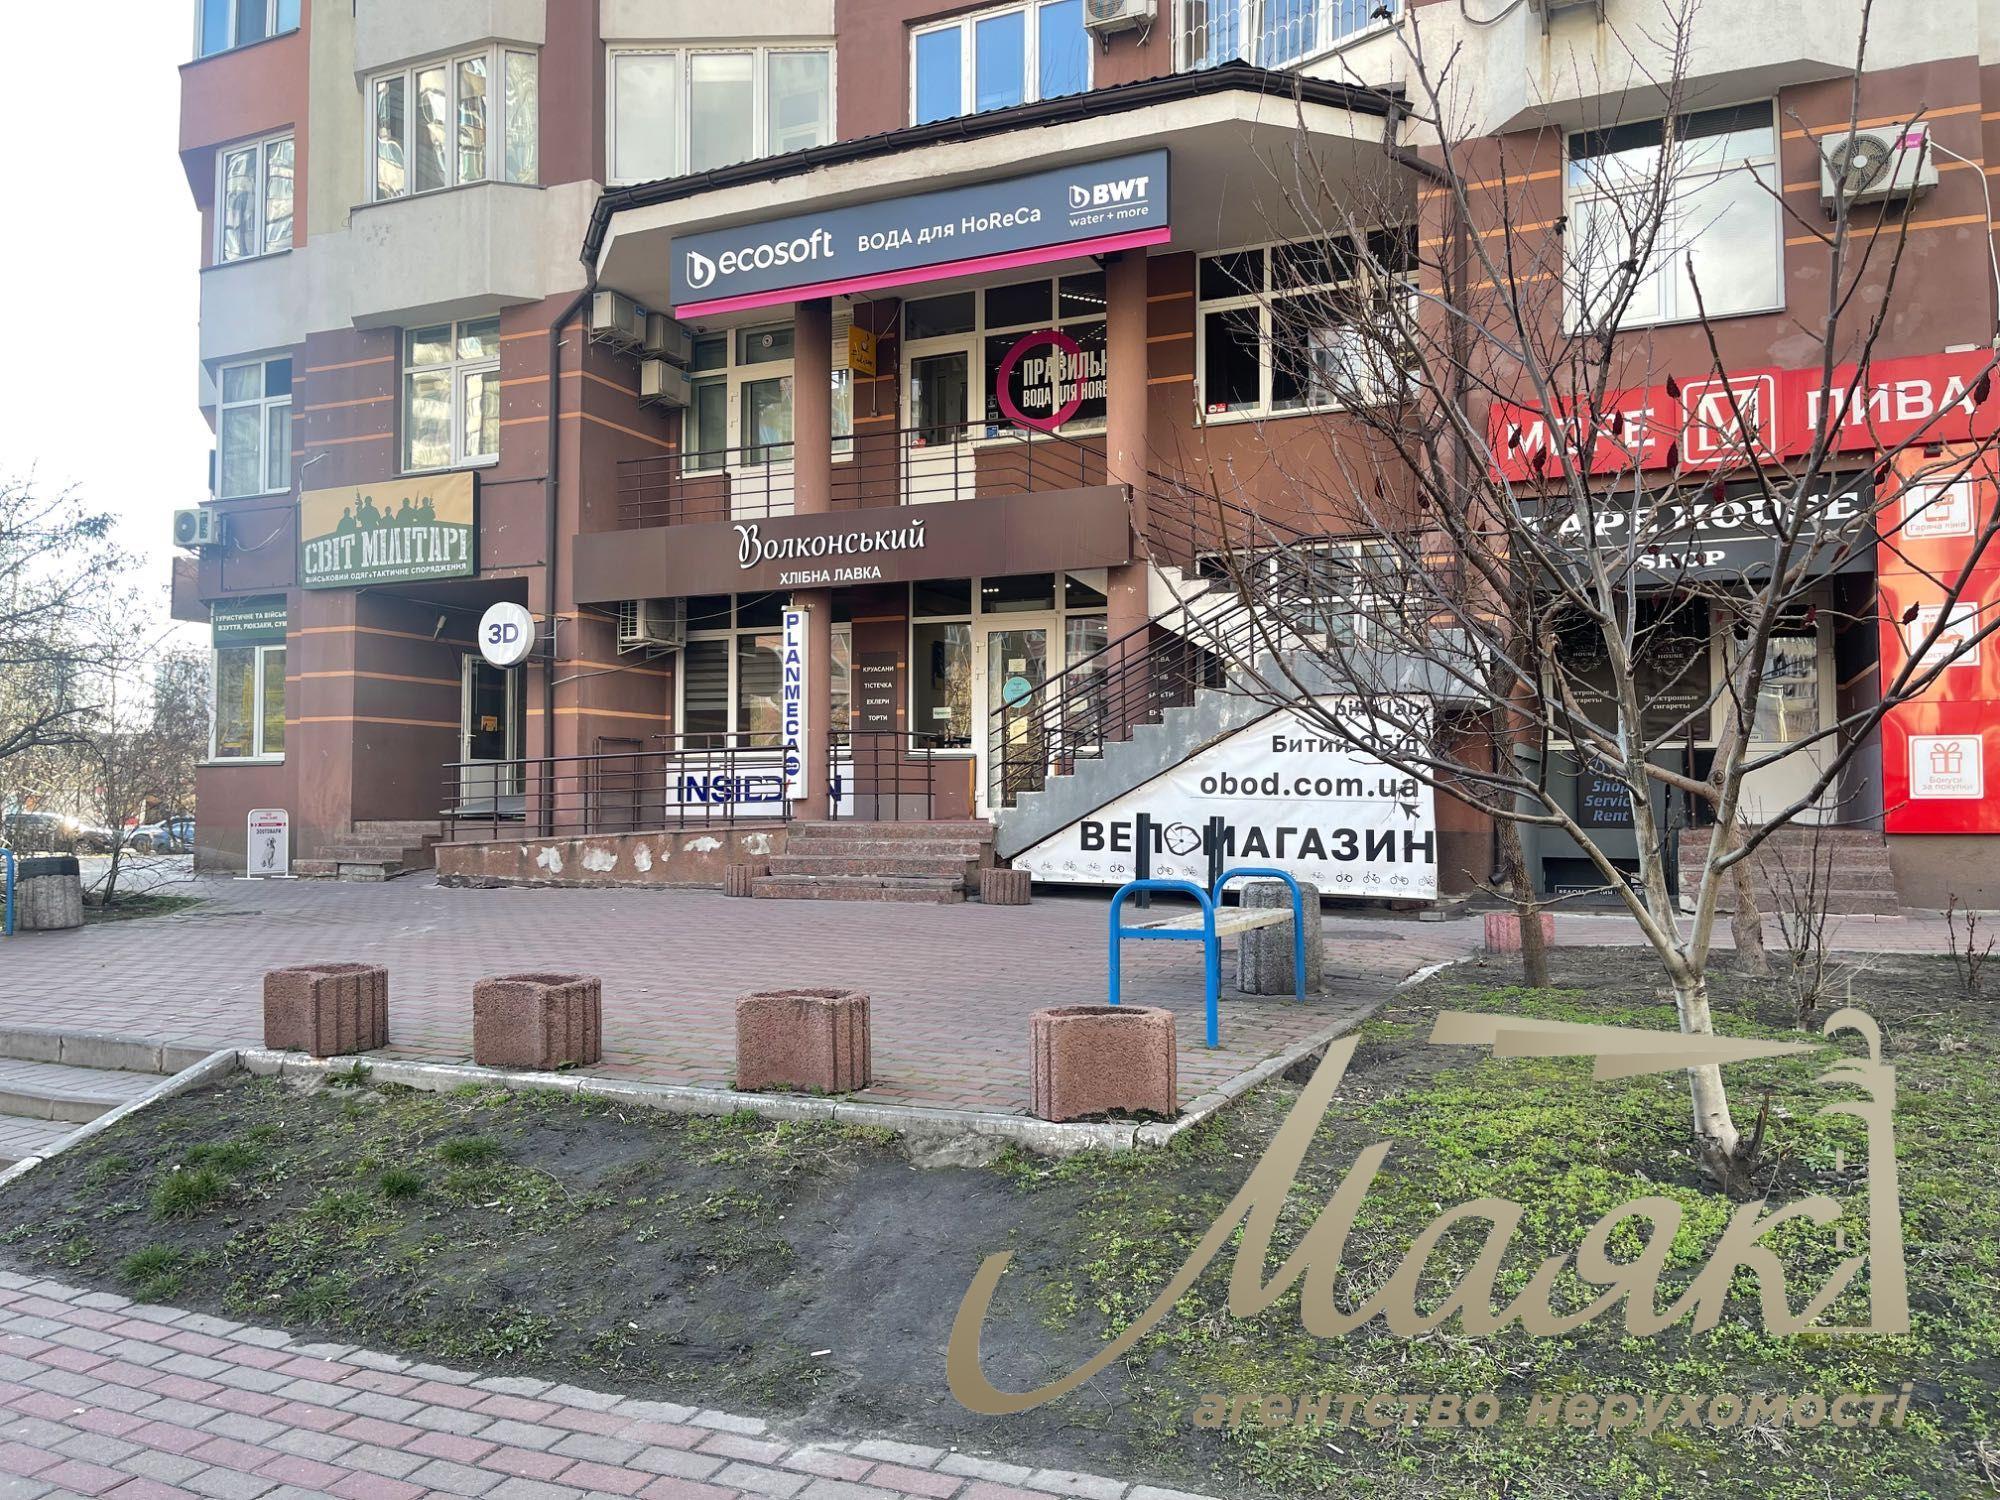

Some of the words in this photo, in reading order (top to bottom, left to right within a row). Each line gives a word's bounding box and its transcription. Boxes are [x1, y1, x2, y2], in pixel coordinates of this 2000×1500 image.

[1092, 176, 1149, 206] BWT
[858, 227, 912, 252] ВОДА
[917, 223, 954, 244] для
[961, 207, 1041, 233] HoReCa
[1069, 211, 1104, 227] water
[1116, 206, 1149, 220] more
[719, 228, 834, 275] ecosoft
[1023, 387, 1052, 408] ВОДА
[1807, 375, 1979, 430] ПИВА
[1670, 492, 1859, 530] HOUSE
[304, 533, 356, 575] СВІТ
[361, 526, 468, 568] МІЛІТАРІ
[733, 519, 926, 569] Волконський
[1637, 550, 1726, 570] SHOP
[779, 570, 831, 585] ХЛІБНА
[834, 566, 881, 581] ЛАВКА
[488, 623, 519, 645] 3D
[785, 613, 801, 753] PLANMECA
[1200, 772, 1419, 798] obod.com.ua
[1593, 809, 1630, 822] Rent
